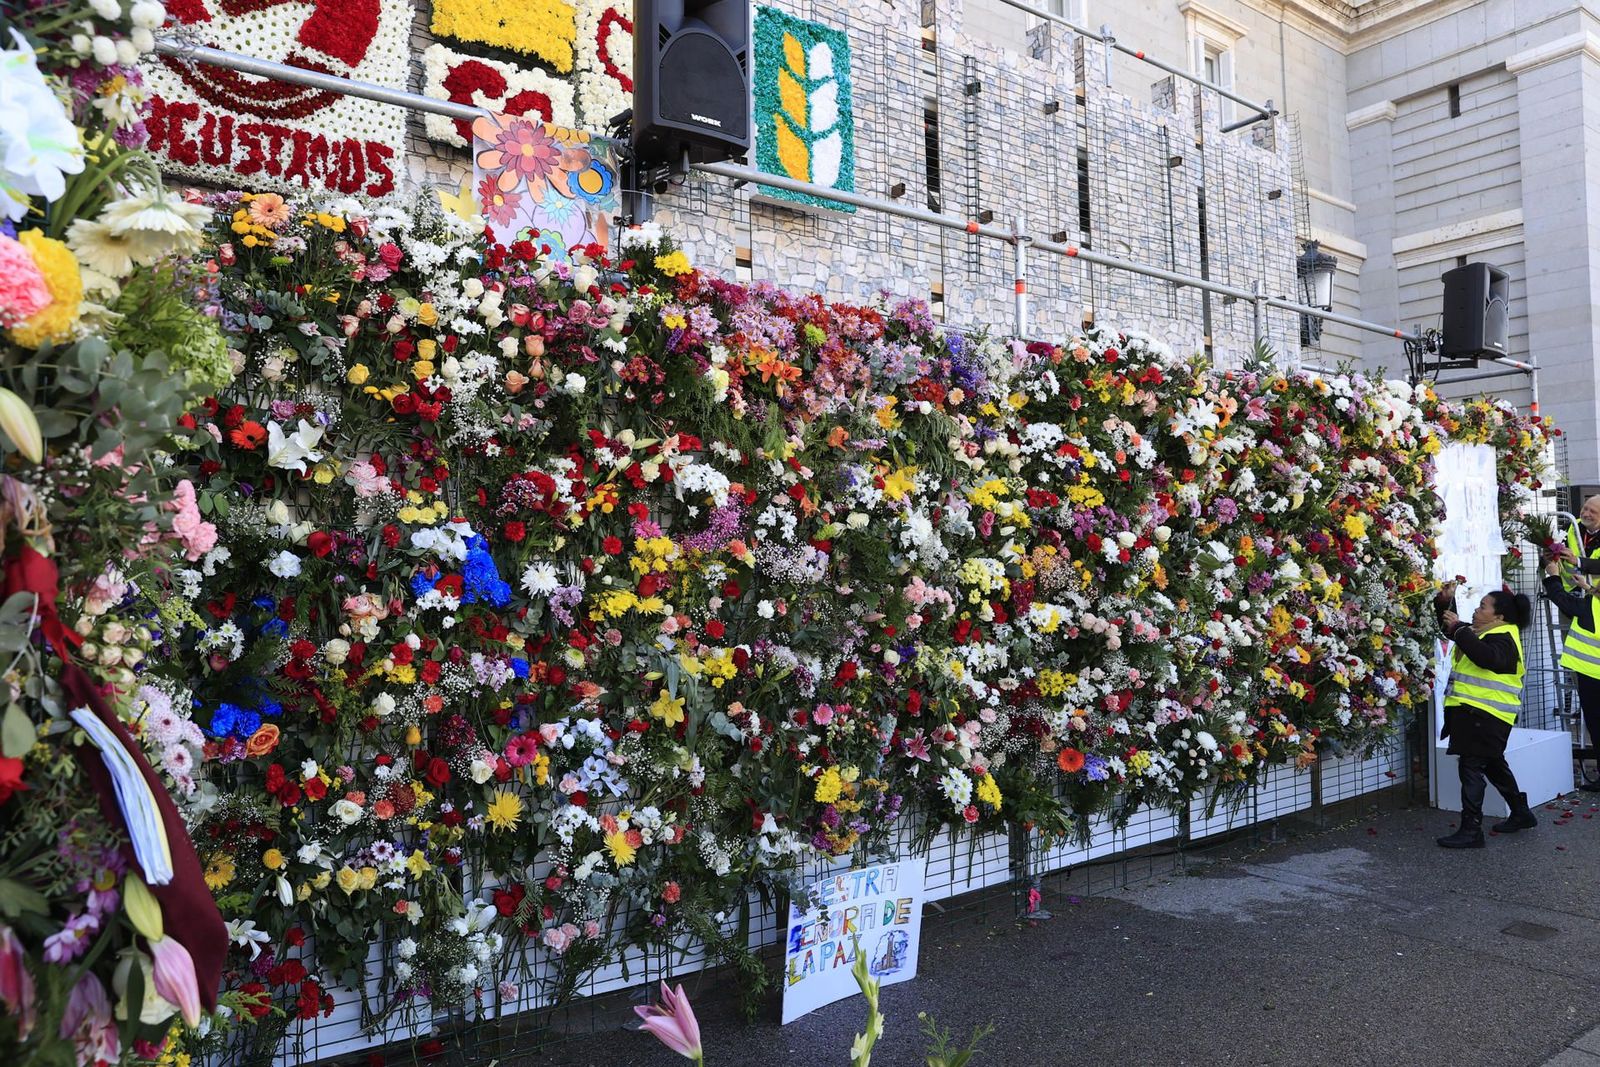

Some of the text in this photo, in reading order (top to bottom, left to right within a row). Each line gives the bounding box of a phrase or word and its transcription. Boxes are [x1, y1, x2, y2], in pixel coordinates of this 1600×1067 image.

[691, 113, 722, 128] WORK
[883, 898, 914, 926] DE
[788, 934, 863, 987] LA PAZ
